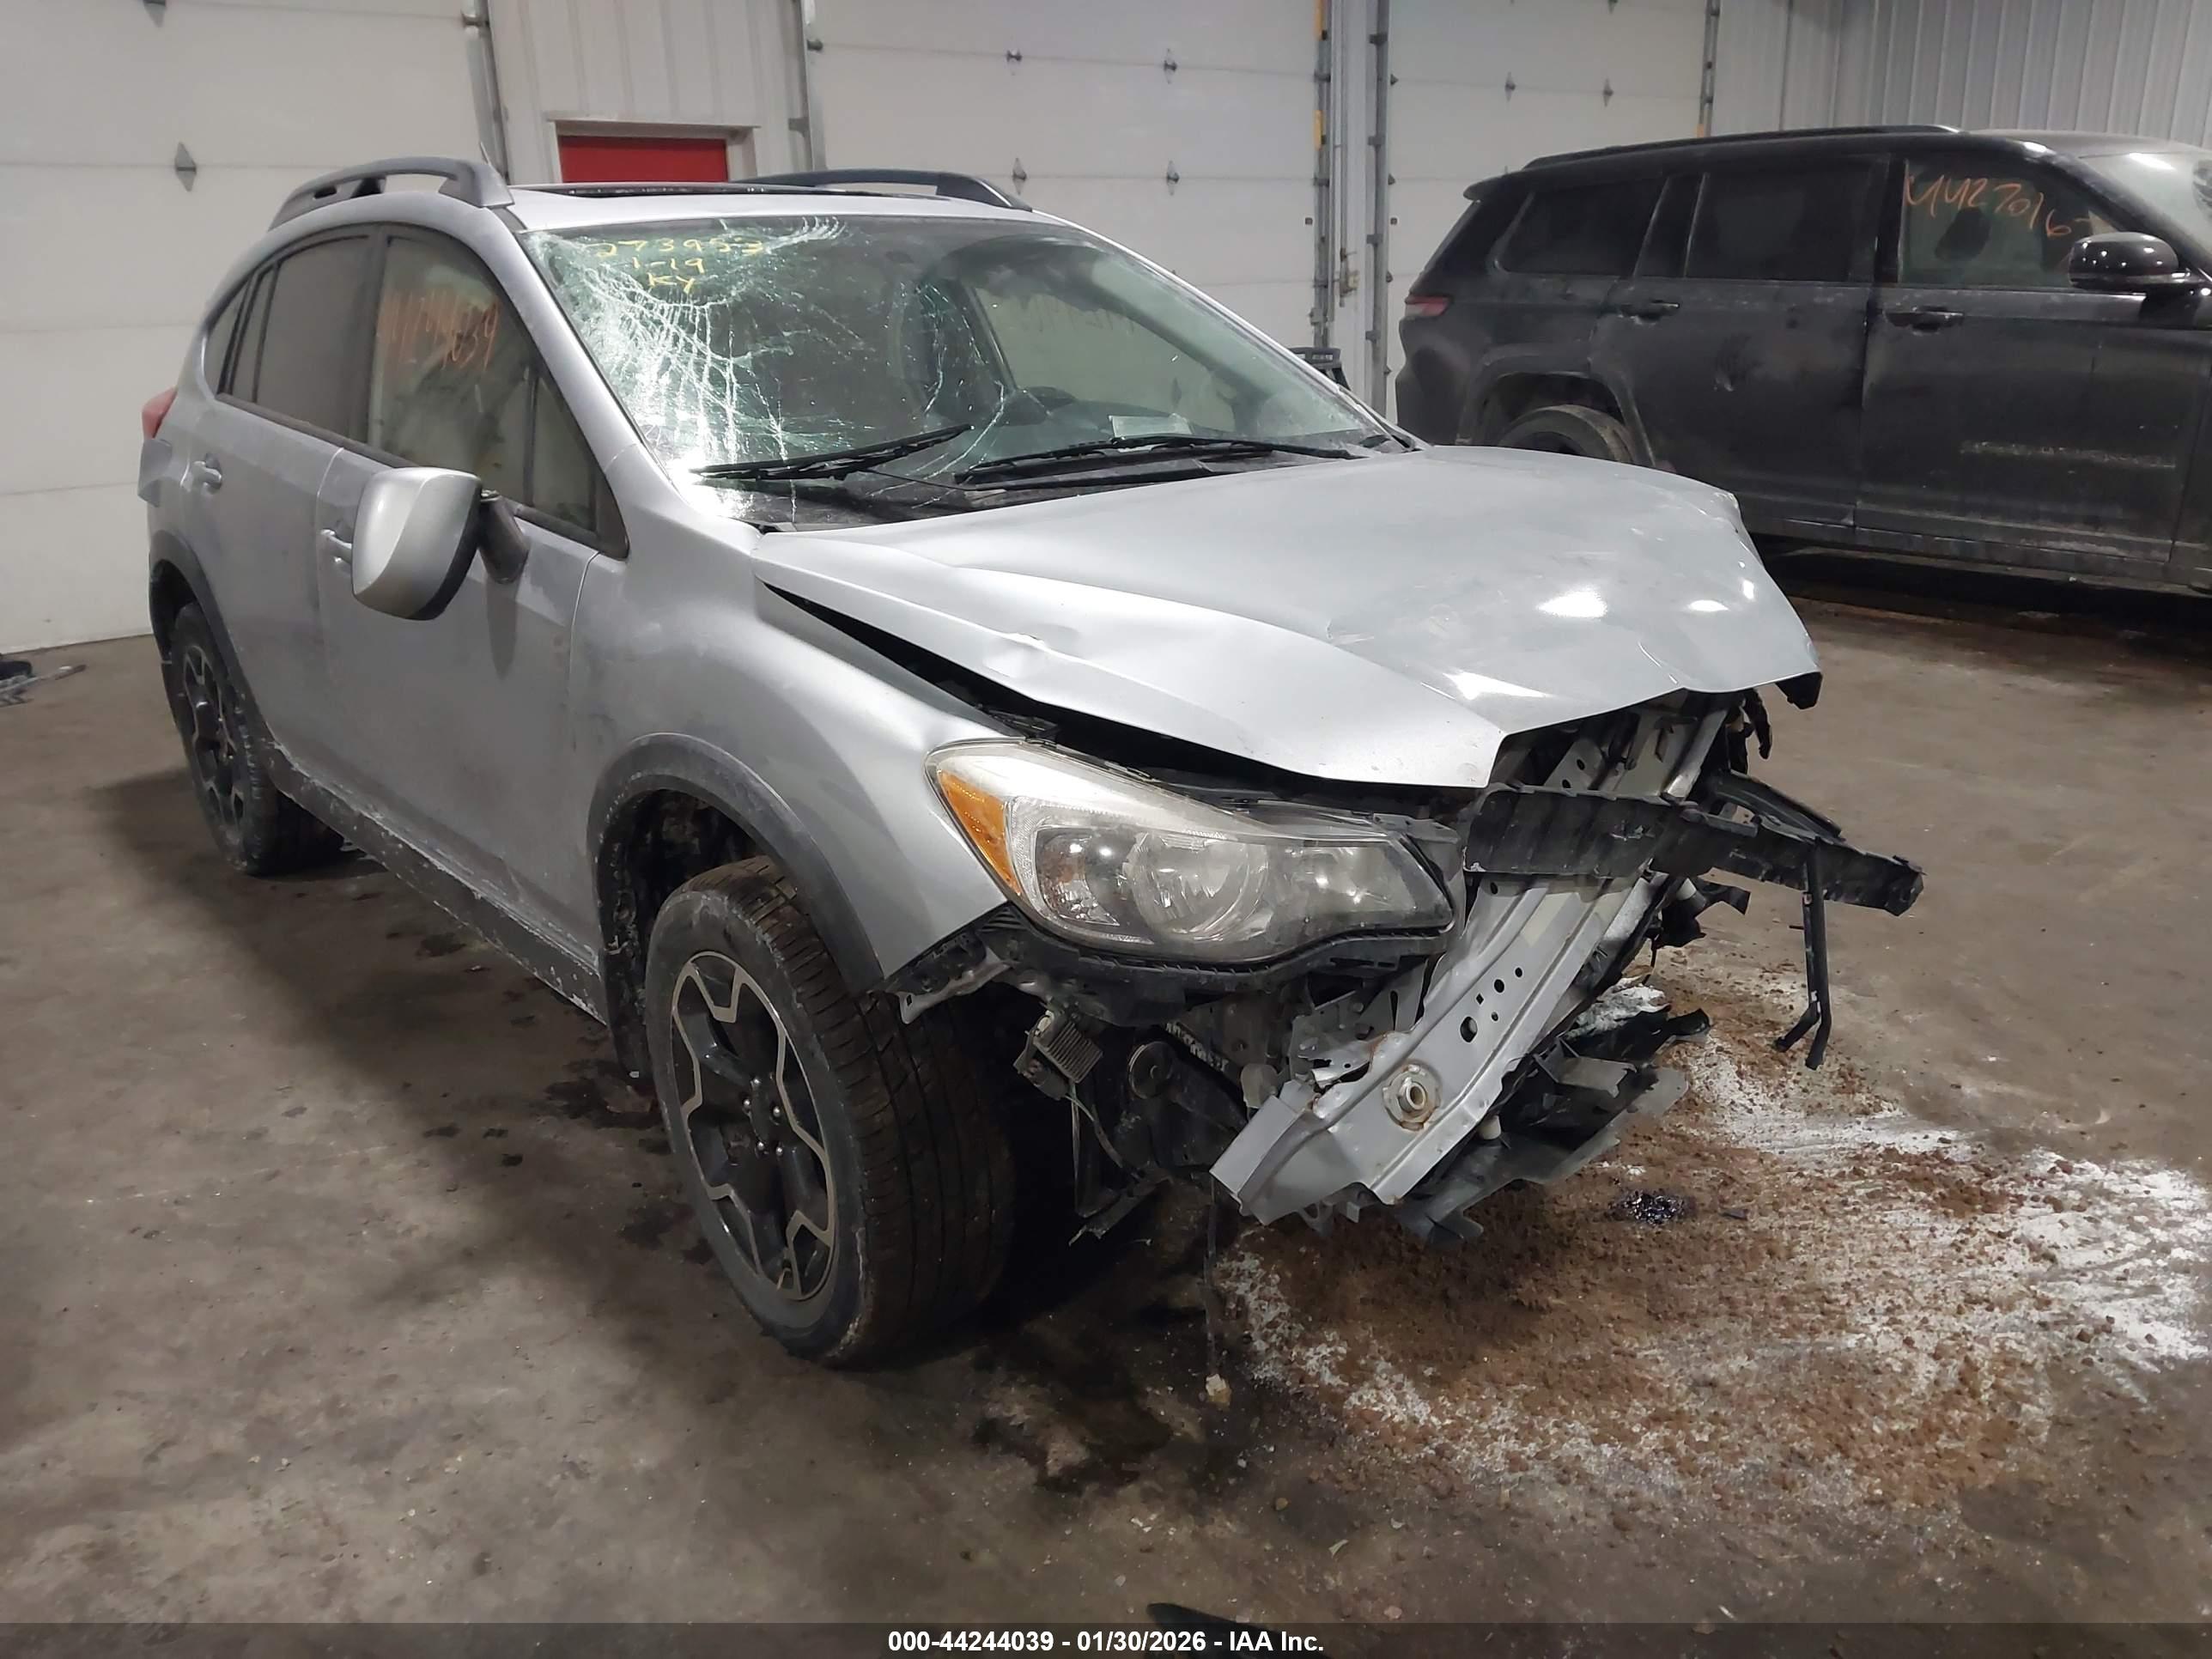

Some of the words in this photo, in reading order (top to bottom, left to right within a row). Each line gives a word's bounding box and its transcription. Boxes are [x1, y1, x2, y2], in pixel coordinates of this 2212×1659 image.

[585, 237, 763, 258] 273953
[632, 257, 704, 274] 1-19
[647, 272, 695, 293] KY
